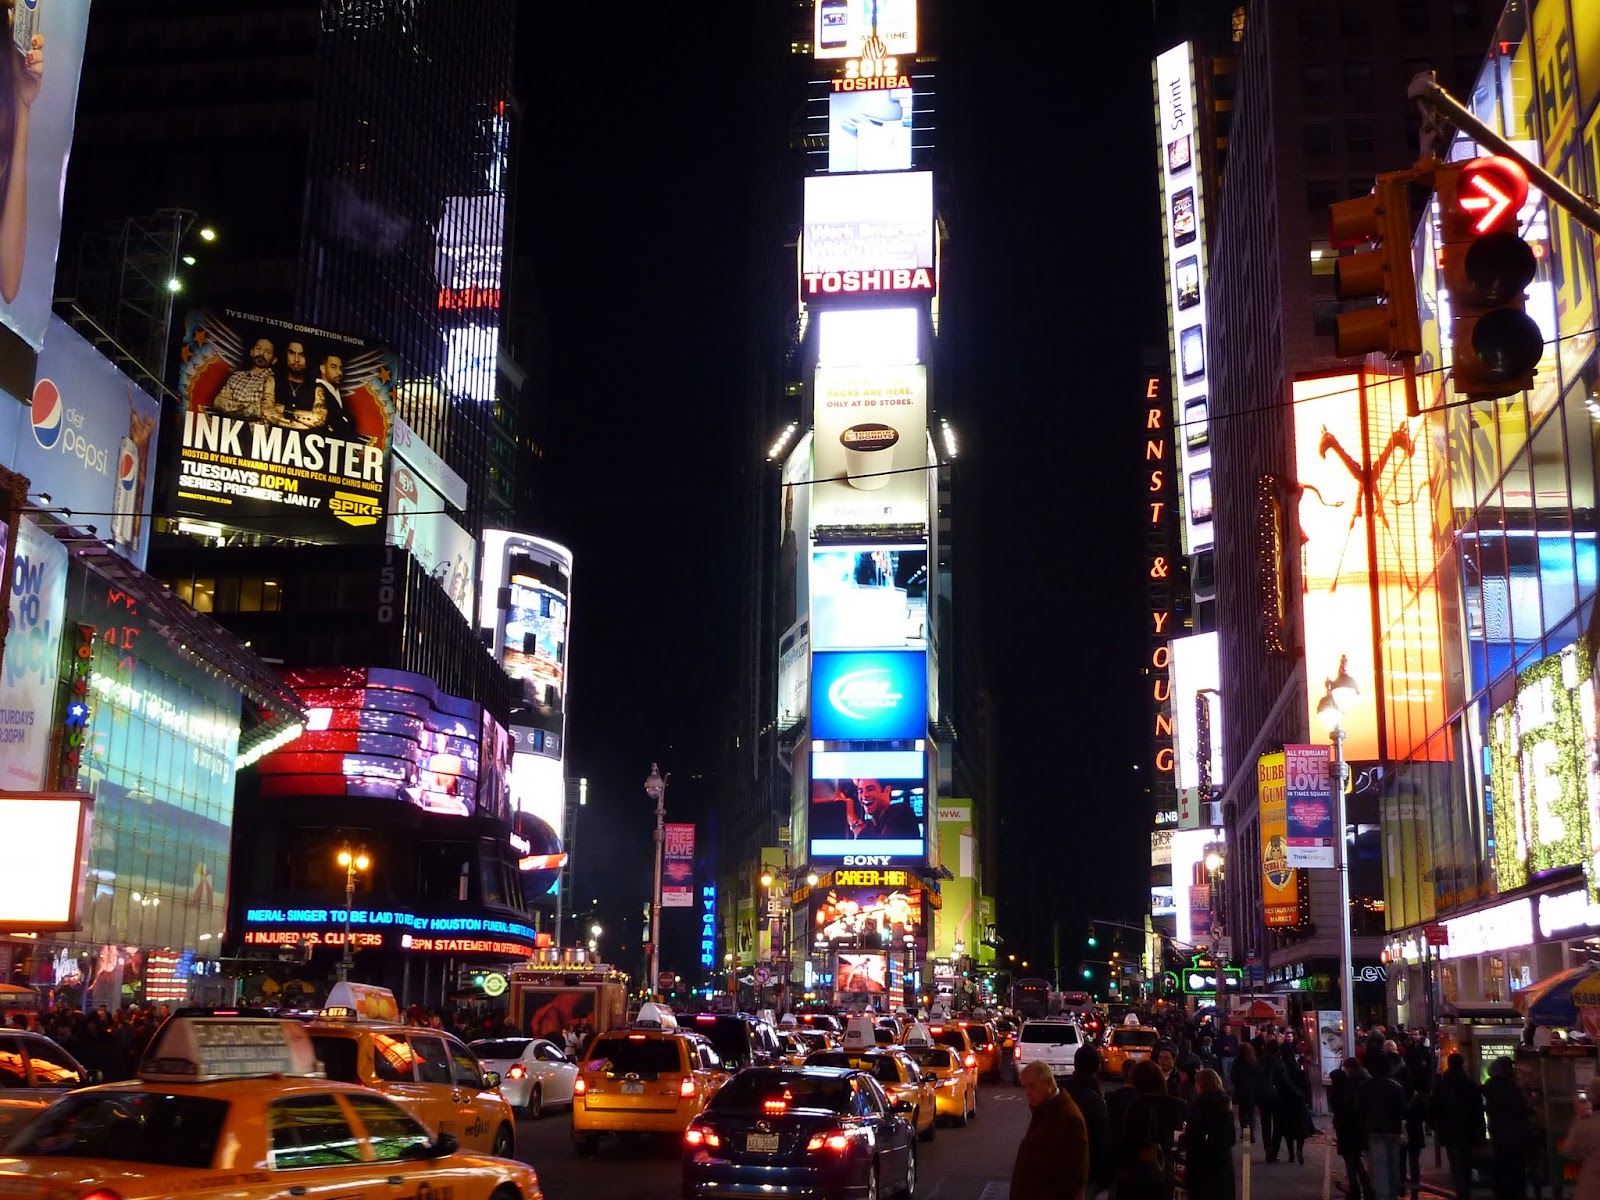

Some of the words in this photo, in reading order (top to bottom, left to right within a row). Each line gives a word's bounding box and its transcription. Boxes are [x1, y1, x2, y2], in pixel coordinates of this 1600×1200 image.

[845, 58, 898, 78] 2012
[832, 76, 910, 91] TOSHIBA
[1169, 77, 1187, 131] Sprint
[804, 269, 931, 293] TOSHIBA
[226, 309, 242, 319] TV'S
[243, 313, 264, 323] FIRST
[266, 317, 293, 330] TATTOO
[294, 324, 342, 341] COMPETITION
[343, 335, 365, 346] SHOW.
[827, 389, 859, 397] PACKS
[886, 387, 913, 396] HERE.
[880, 398, 914, 406] STORES.
[66, 408, 85, 428] diet
[63, 428, 108, 475] pepsi
[182, 410, 244, 457] INK
[251, 424, 383, 483] MASTER
[1146, 378, 1164, 523] ERNST
[181, 460, 259, 486] TUESDAYS
[260, 473, 298, 493] 10PM
[182, 449, 208, 462] HOSTED
[209, 454, 219, 463] BY
[220, 456, 238, 467] DAVE
[238, 458, 269, 471] NAVARRO
[269, 463, 286, 474] WITH
[287, 466, 310, 479] OLIVER
[310, 471, 327, 481] PECK
[327, 474, 341, 484] AND
[342, 476, 361, 488] CHRIS
[179, 475, 222, 493] SERIES
[224, 482, 283, 502] PREMIERE
[284, 493, 308, 507] JAN
[309, 497, 321, 509] 17
[1150, 557, 1168, 577] &
[1153, 612, 1174, 771] YOUNG
[0, 709, 34, 726] TURDAYS
[1259, 764, 1285, 782] BUBB
[1286, 757, 1329, 773] FREE
[1286, 773, 1330, 791] LOVE
[1165, 811, 1178, 822] NB
[1262, 815, 1287, 824] COMPAN
[665, 832, 693, 844] FREE
[664, 844, 693, 855] LOVE
[843, 856, 891, 865] SONY
[287, 910, 327, 922] SINGER
[330, 910, 347, 922] TO
[350, 910, 368, 923] BE
[369, 911, 393, 924] LAID
[394, 912, 404, 924] TO
[1265, 906, 1297, 915] RESTAURANT
[1270, 915, 1292, 923] MARKET
[430, 919, 481, 930] HOUSTON
[256, 932, 299, 943] INJURED
[435, 940, 492, 952] STATEMENT
